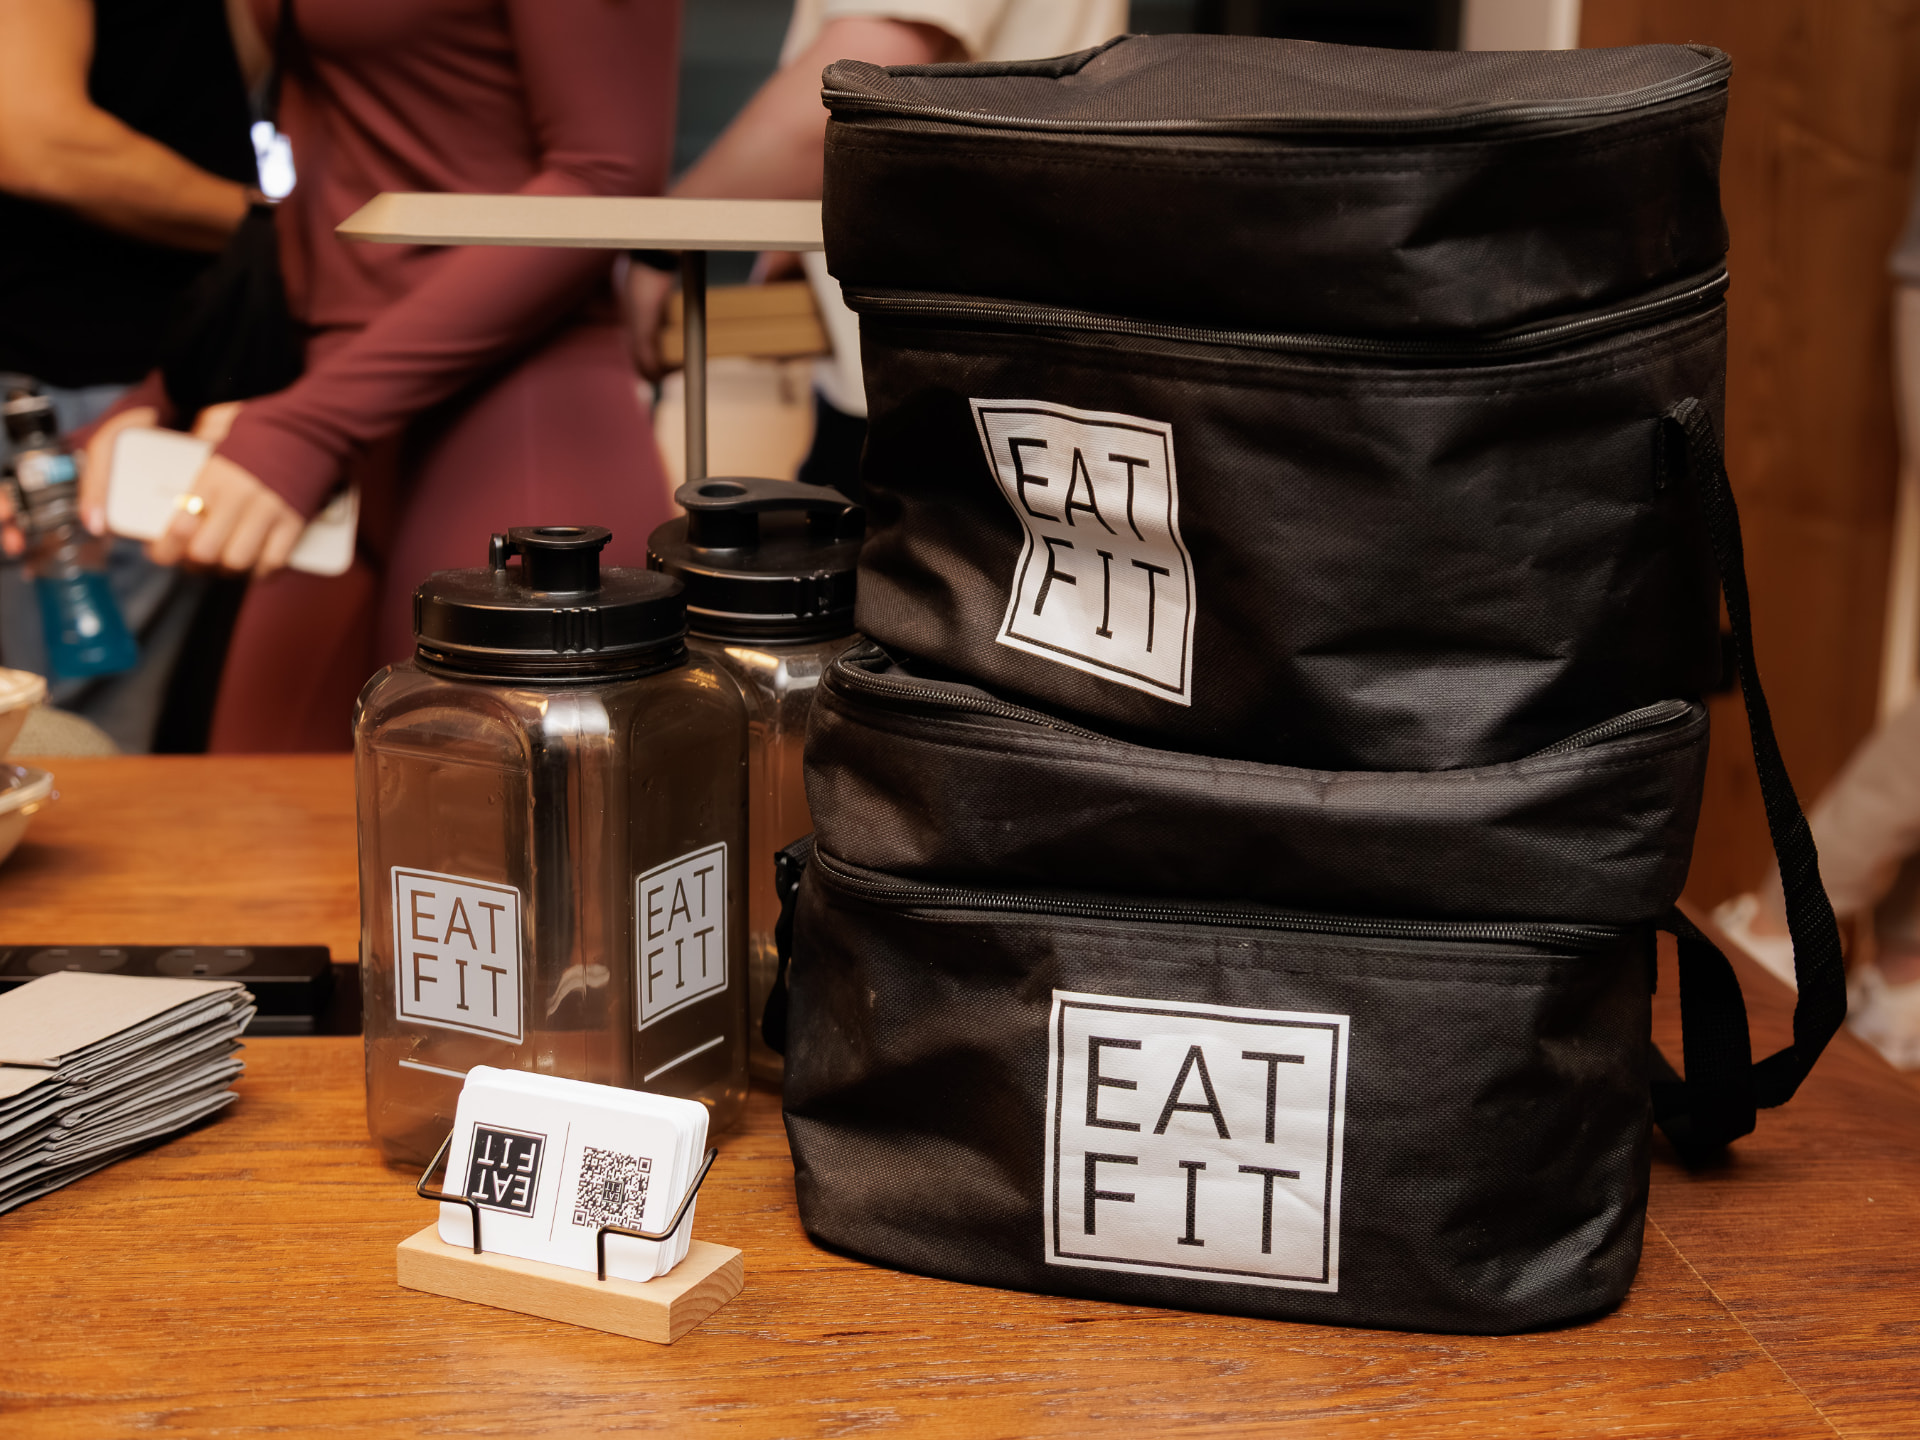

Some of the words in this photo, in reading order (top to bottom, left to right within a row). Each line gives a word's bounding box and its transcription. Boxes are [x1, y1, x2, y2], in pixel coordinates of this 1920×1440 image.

[1008, 437, 1149, 542] EAT
[1033, 535, 1170, 653] FIT
[410, 890, 505, 954] EAT
[647, 865, 714, 942] EAT
[412, 952, 507, 1018] FIT
[648, 926, 714, 1004] FIT
[1085, 1035, 1305, 1144] EAT
[471, 1169, 531, 1207] EAT
[477, 1135, 536, 1173] FIT
[605, 1182, 622, 1192] FIT
[603, 1191, 620, 1202] EAT
[1084, 1151, 1300, 1255] FIT
